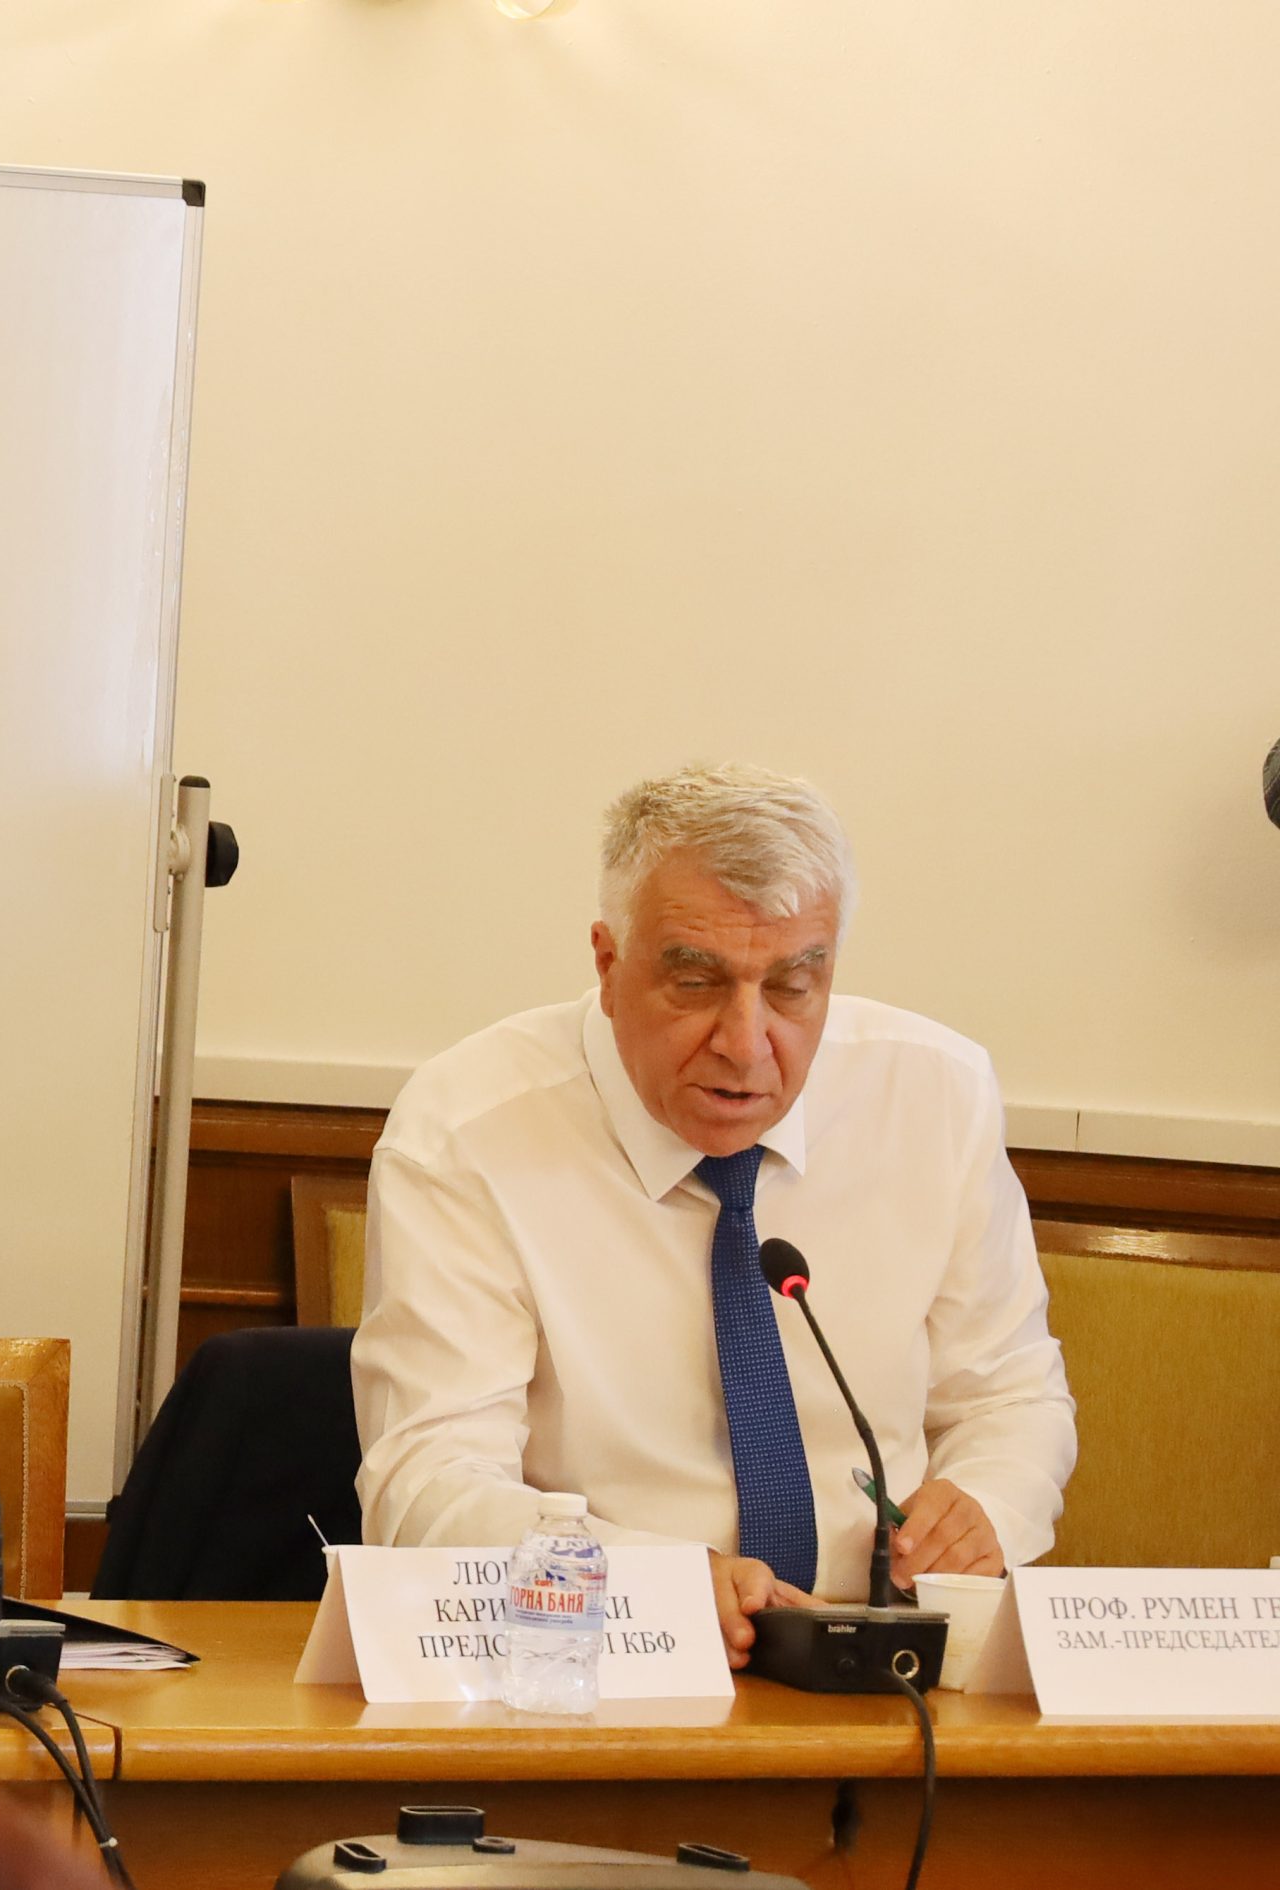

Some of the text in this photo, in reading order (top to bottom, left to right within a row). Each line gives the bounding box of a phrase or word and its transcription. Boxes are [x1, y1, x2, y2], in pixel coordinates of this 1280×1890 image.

[510, 1586, 543, 1611] ГОРНА
[548, 1592, 584, 1613] БАНЯ
[1048, 1596, 1136, 1620] ПРОФ.
[1142, 1597, 1240, 1619] РУМЕН
[620, 1630, 676, 1655] КБФ
